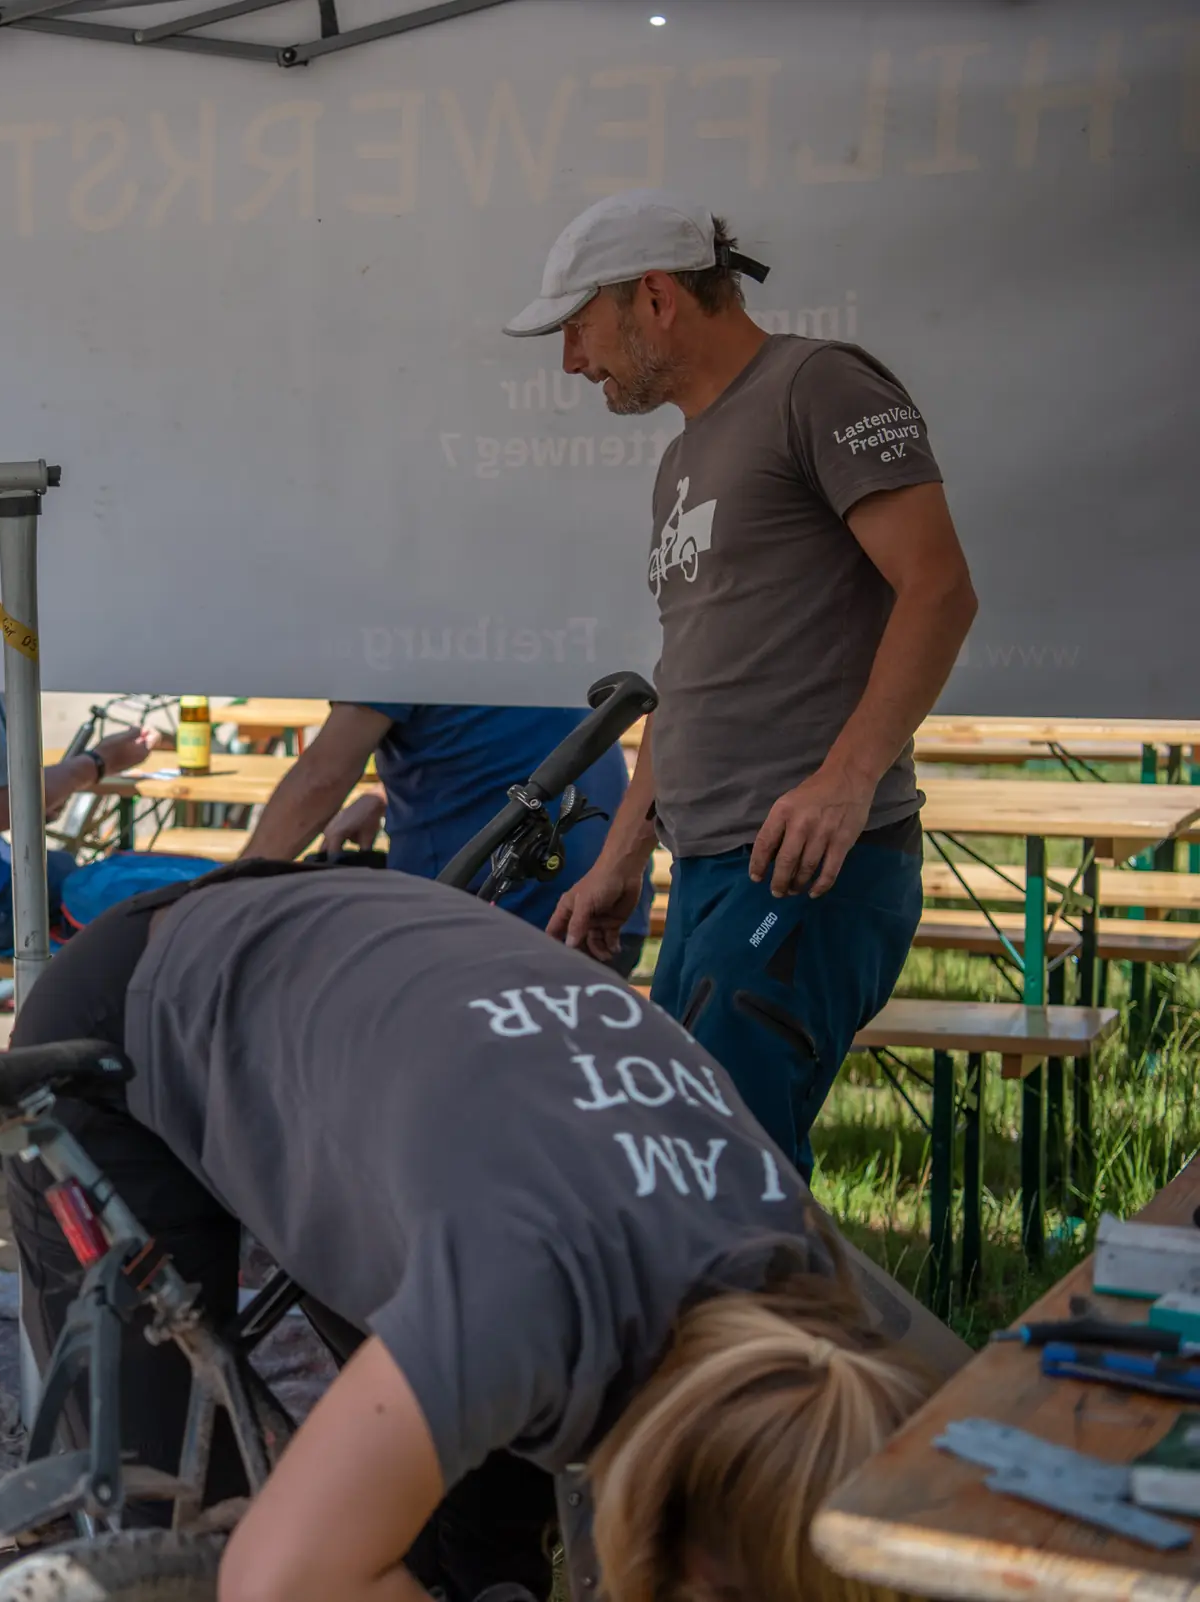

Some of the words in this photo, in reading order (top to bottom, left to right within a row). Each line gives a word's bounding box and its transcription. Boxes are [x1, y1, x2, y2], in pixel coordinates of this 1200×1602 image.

[833, 405, 921, 444] LastenVelo
[848, 424, 919, 455] Freiburg
[880, 442, 906, 462] e.V.
[749, 911, 779, 948] ARSUXED
[468, 983, 643, 1038] CAR
[571, 1054, 733, 1117] NOT
[614, 1132, 728, 1201] AM
[760, 1148, 787, 1201] I
